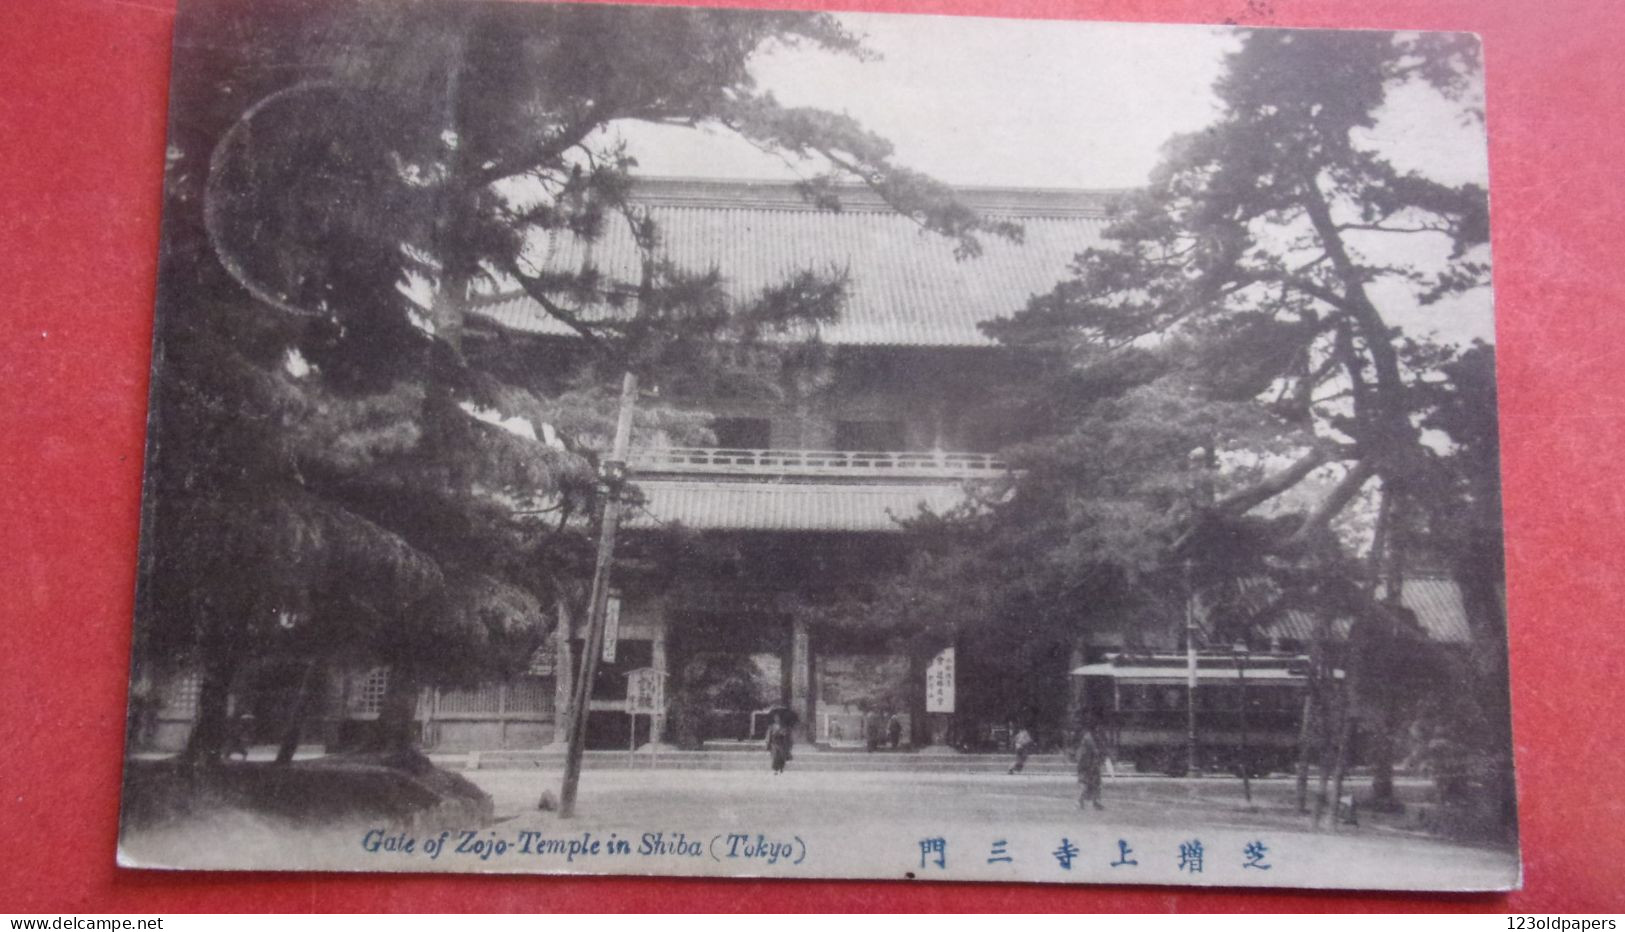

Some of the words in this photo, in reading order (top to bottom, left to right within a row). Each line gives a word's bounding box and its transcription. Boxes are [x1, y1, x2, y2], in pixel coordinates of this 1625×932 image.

[362, 829, 415, 854] Gate
[423, 831, 450, 860] of
[454, 830, 601, 862] Zojo-Temple
[606, 833, 631, 855] in
[637, 832, 702, 857] Shiba
[709, 834, 806, 864] (Tokyo)
